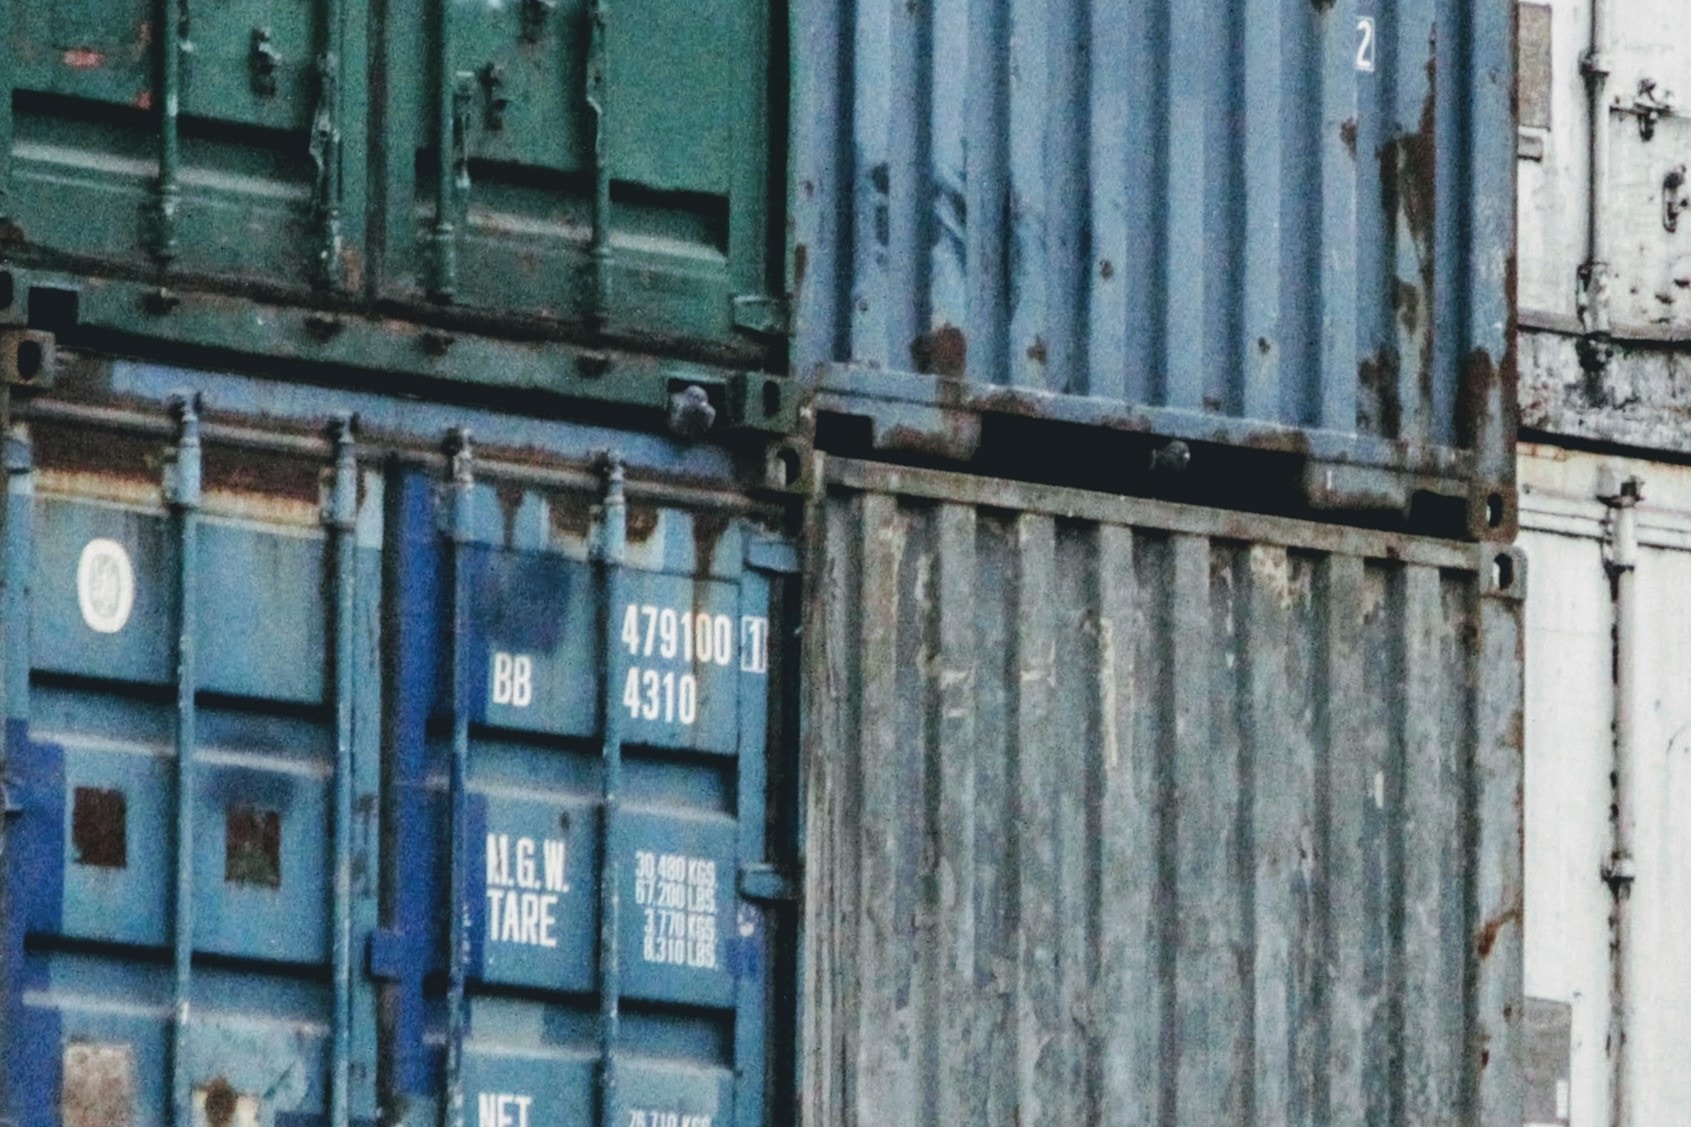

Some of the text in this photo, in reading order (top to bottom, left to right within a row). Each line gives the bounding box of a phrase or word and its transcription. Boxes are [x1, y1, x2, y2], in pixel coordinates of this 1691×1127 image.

[1356, 18, 1374, 69] 2
[621, 603, 766, 672] 479100 1
[492, 651, 532, 708] BB
[622, 666, 697, 725] 4310
[486, 889, 558, 948] TARE
